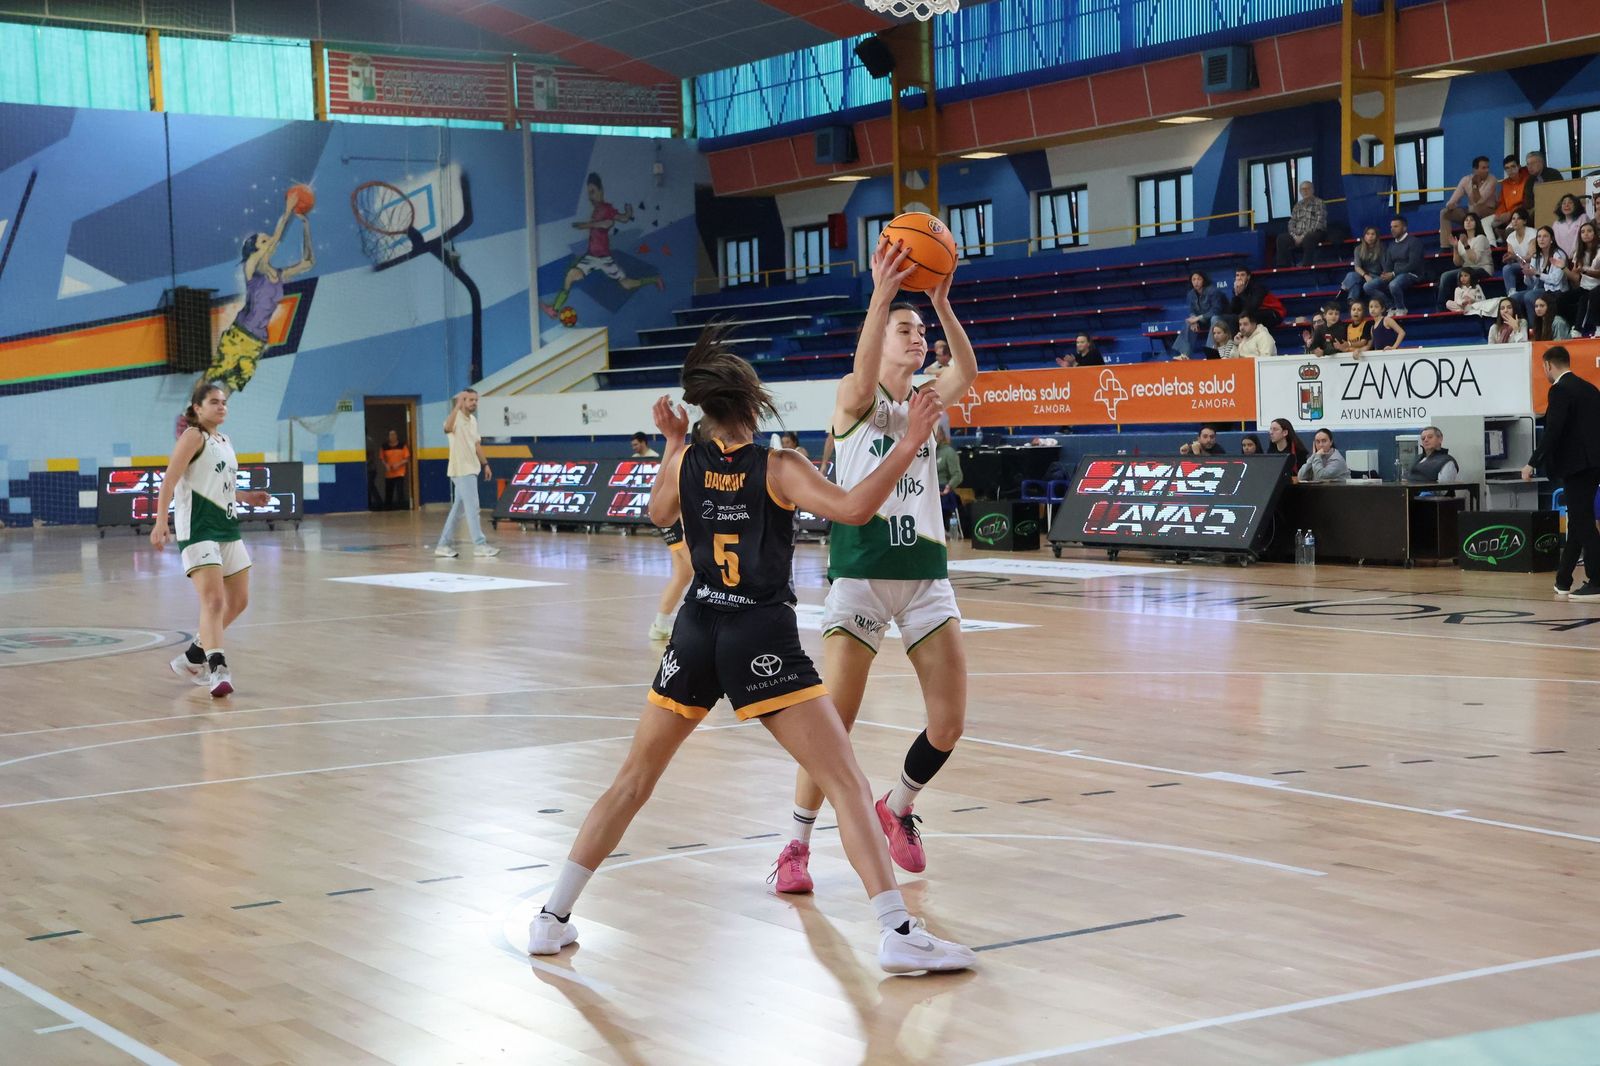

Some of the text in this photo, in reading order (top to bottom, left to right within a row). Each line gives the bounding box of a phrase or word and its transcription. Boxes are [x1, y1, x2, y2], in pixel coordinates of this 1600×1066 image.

[1131, 373, 1235, 398] recoletas salud
[1340, 357, 1482, 400] ZAMORA
[983, 382, 1071, 403] recoletas salud
[1033, 404, 1071, 414] ZAMORA
[1191, 398, 1236, 409] ZAMORA
[1340, 407, 1427, 420] AYUNTAMIENTO
[716, 512, 750, 521] ZAMORA
[889, 514, 917, 546] 18
[713, 533, 741, 587] 5
[728, 594, 757, 605] RURAL
[758, 681, 769, 689] DE
[769, 678, 779, 687] LA
[779, 673, 799, 684] PLATA
